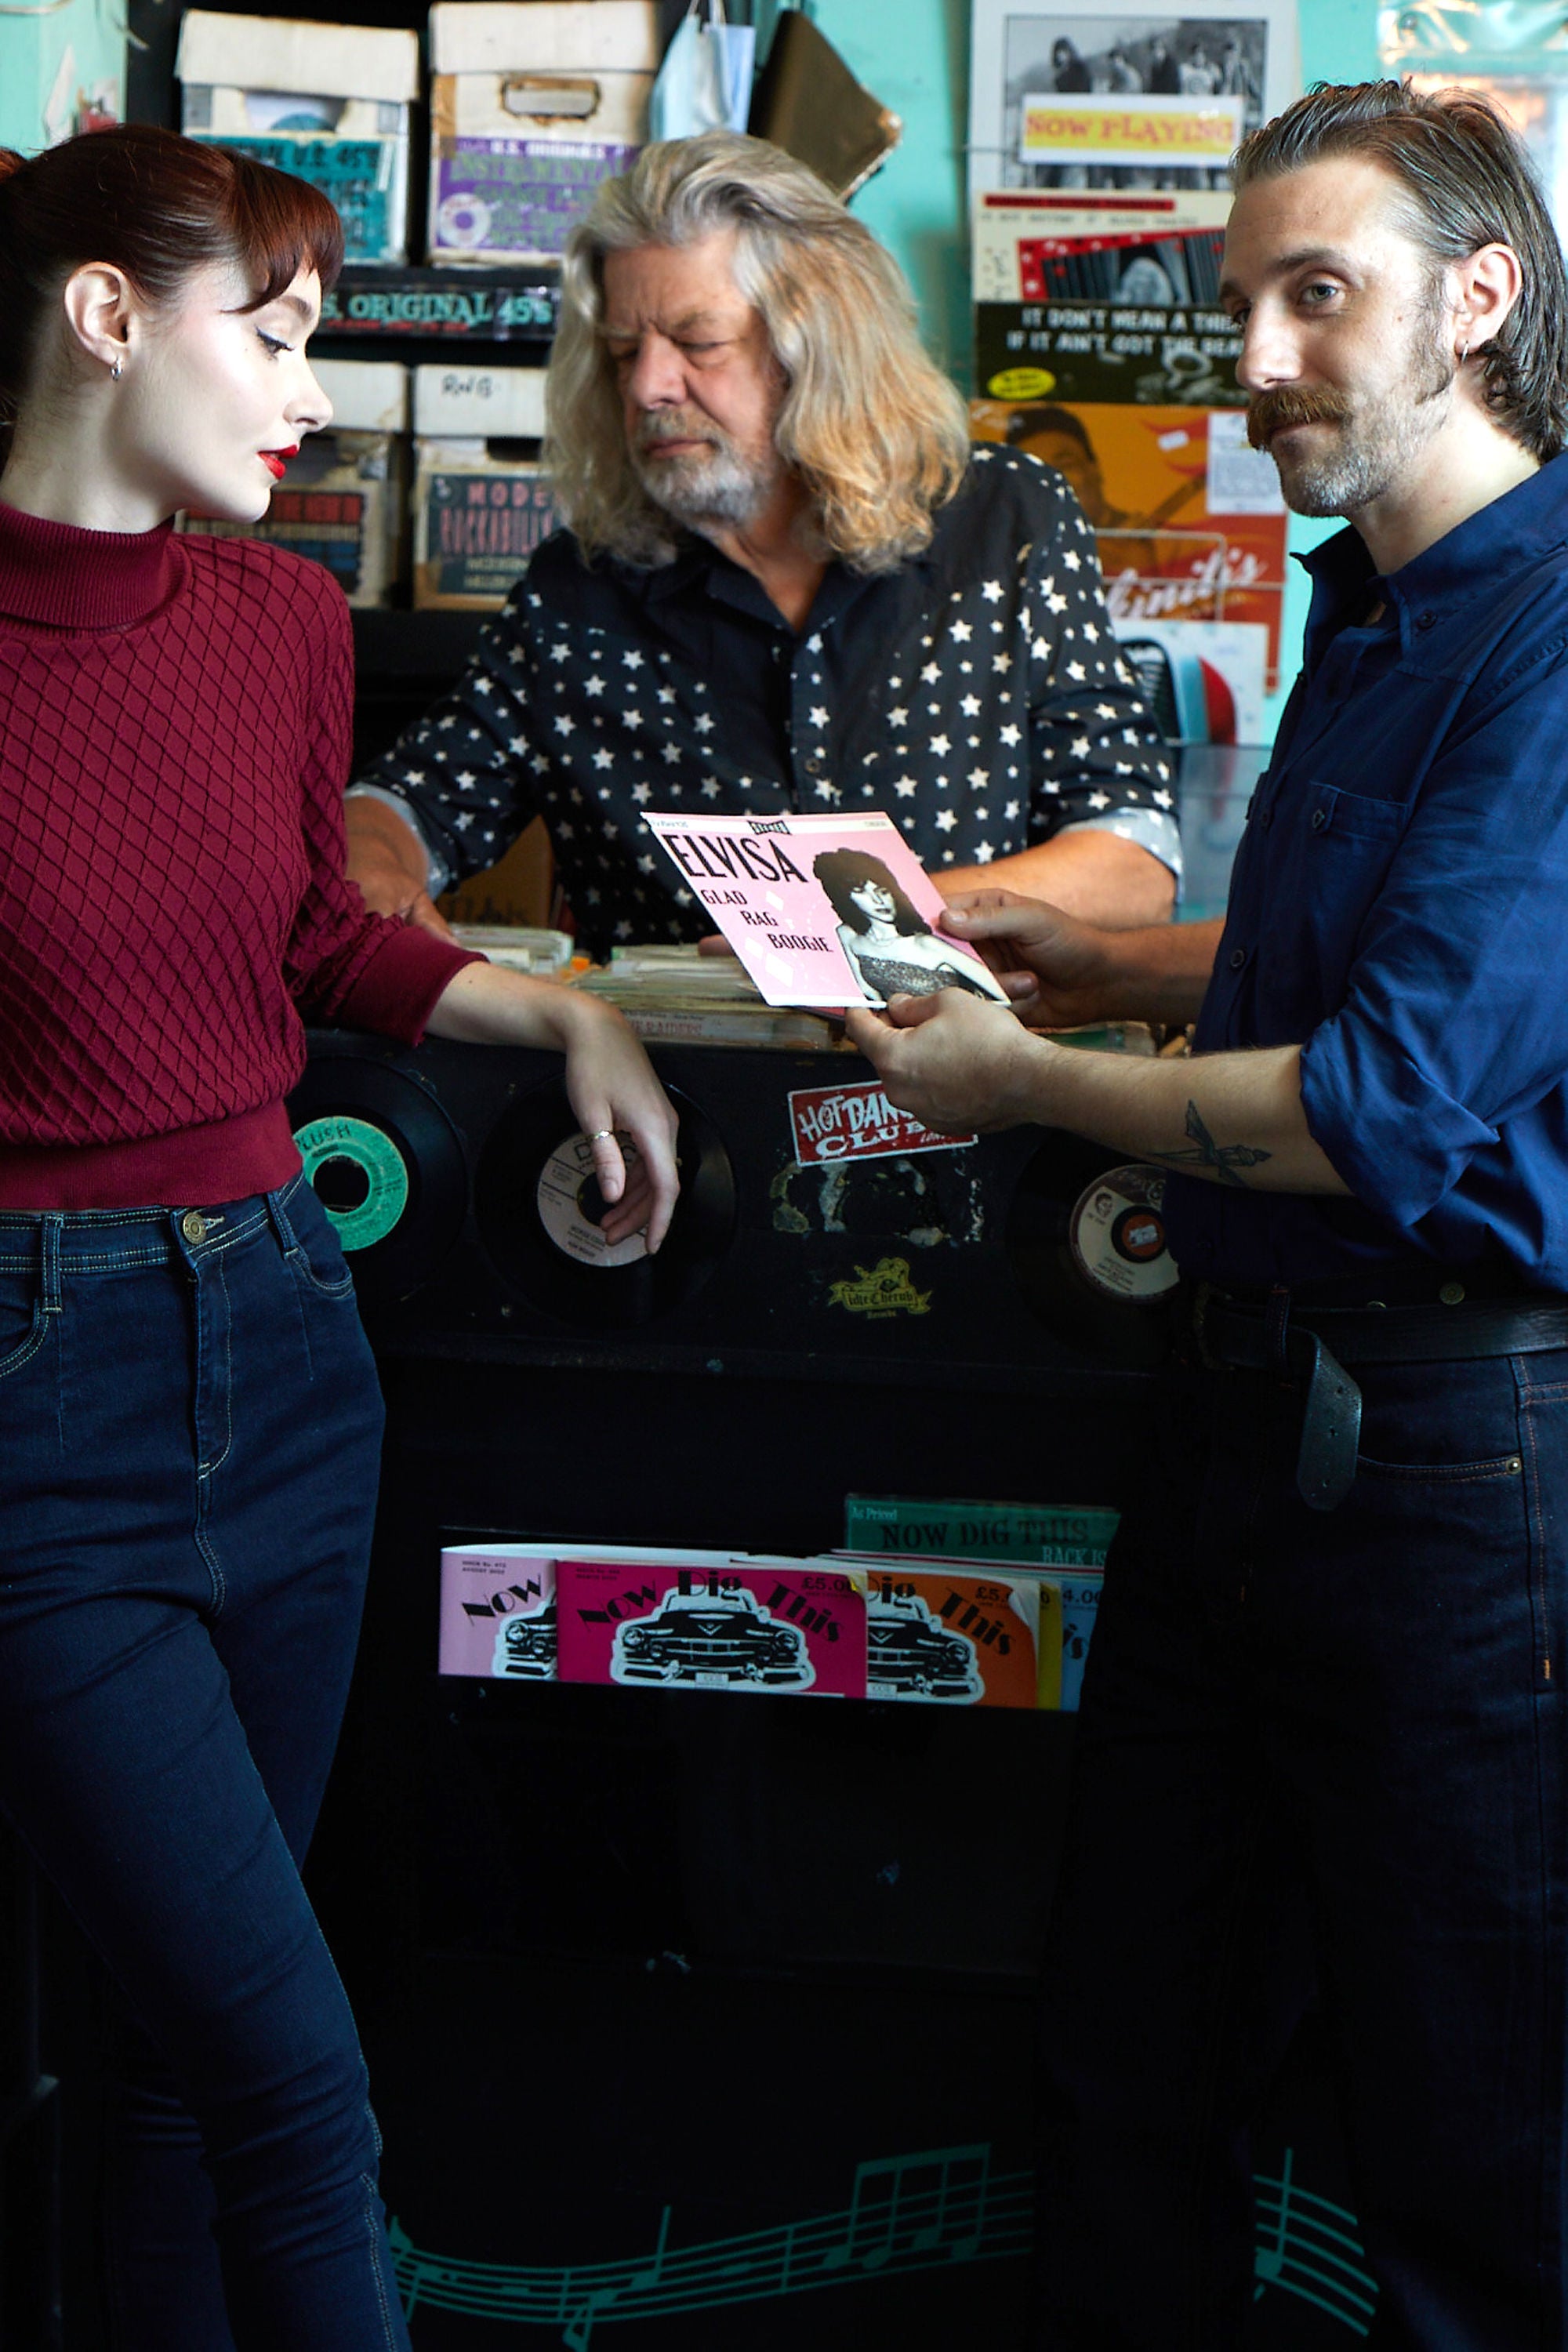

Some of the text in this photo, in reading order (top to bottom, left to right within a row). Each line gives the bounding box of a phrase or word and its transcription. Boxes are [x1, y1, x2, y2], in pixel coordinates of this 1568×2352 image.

[1025, 114, 1236, 144] NOW PLAYING
[347, 291, 494, 328] ORIGINAL
[1021, 307, 1044, 329] IT
[1047, 308, 1107, 331] DON'T
[1112, 310, 1168, 332] MEAN
[1169, 311, 1188, 333] A
[1007, 330, 1027, 351] IF
[1029, 331, 1052, 352] IT
[1055, 332, 1107, 354] AIN'T
[1112, 334, 1156, 356] GOT
[466, 480, 552, 509] MODE
[661, 833, 808, 884] ELVISA
[701, 888, 748, 906] GLAD
[742, 911, 779, 927] RAG
[768, 933, 833, 953] BOOGIE
[797, 1094, 847, 1142] HOT
[815, 1120, 927, 1159] CLUB
[881, 1519, 1089, 1549] NOW DIG THIS
[1042, 1545, 1087, 1566] BACK
[461, 1573, 542, 1626] NOW
[576, 1570, 844, 1642] NOW Dig This
[975, 1586, 1014, 1602] £5.
[938, 1586, 1016, 1656] This
